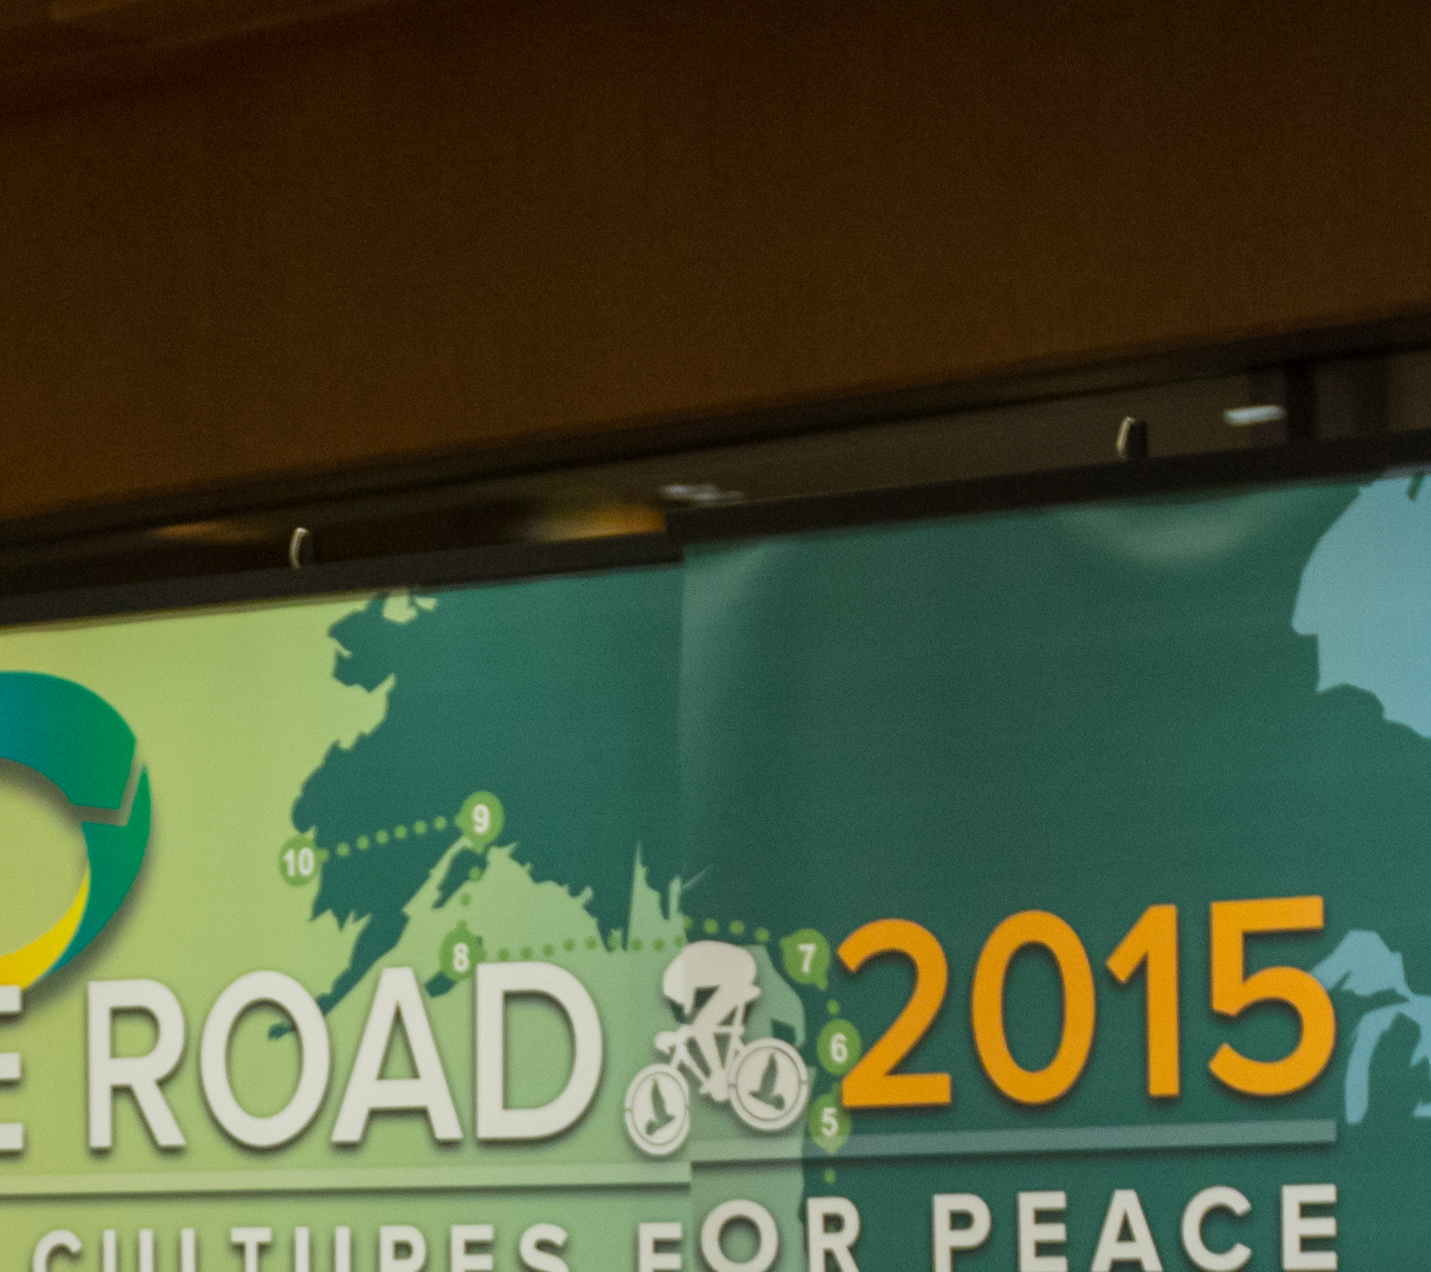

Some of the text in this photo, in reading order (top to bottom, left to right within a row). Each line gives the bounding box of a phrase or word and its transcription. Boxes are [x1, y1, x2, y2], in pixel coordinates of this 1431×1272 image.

[472, 804, 490, 834] 9
[284, 847, 314, 877] 10
[453, 942, 470, 972] 8
[798, 943, 816, 973] 7
[87, 960, 603, 1149] ROAD
[838, 896, 1336, 1107] 2015
[830, 1032, 848, 1063] 6
[821, 1107, 838, 1137] 5
